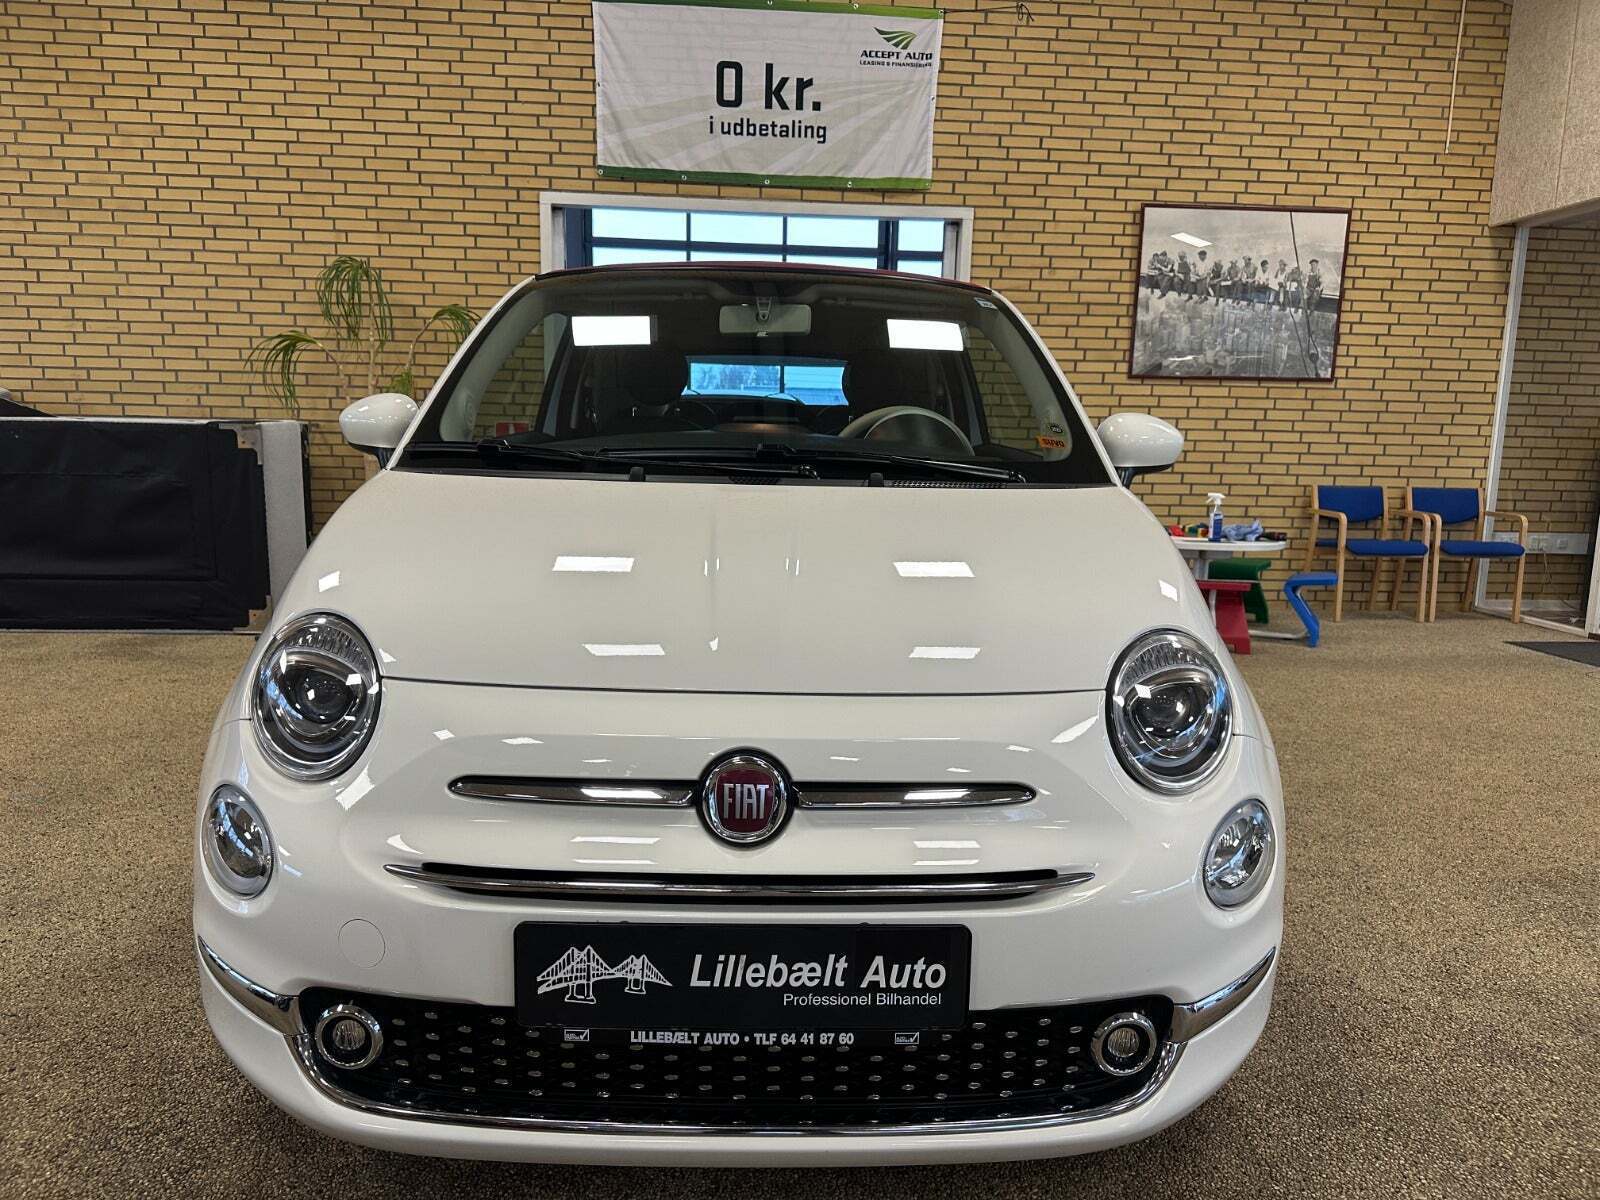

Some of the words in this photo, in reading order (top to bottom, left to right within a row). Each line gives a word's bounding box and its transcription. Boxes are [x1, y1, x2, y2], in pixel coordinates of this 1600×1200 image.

[860, 50, 900, 59] ACCEPT
[905, 52, 932, 60] AUTO
[716, 60, 743, 108] 0
[764, 63, 821, 111] kr.
[709, 115, 714, 134] i
[720, 117, 827, 144] udbetaling
[722, 783, 770, 820] FIAT
[689, 954, 848, 988] Lillebælt
[860, 955, 946, 989] Auto
[783, 993, 871, 1006] Professionel
[876, 993, 942, 1006] Bilhandel
[630, 1030, 700, 1044] LILLEBÆLT
[703, 1032, 740, 1045] AUTO
[753, 1033, 777, 1046] TLF
[780, 1033, 796, 1045] 64
[800, 1033, 814, 1045] 41
[819, 1033, 834, 1045] 87
[838, 1033, 854, 1045] 60
